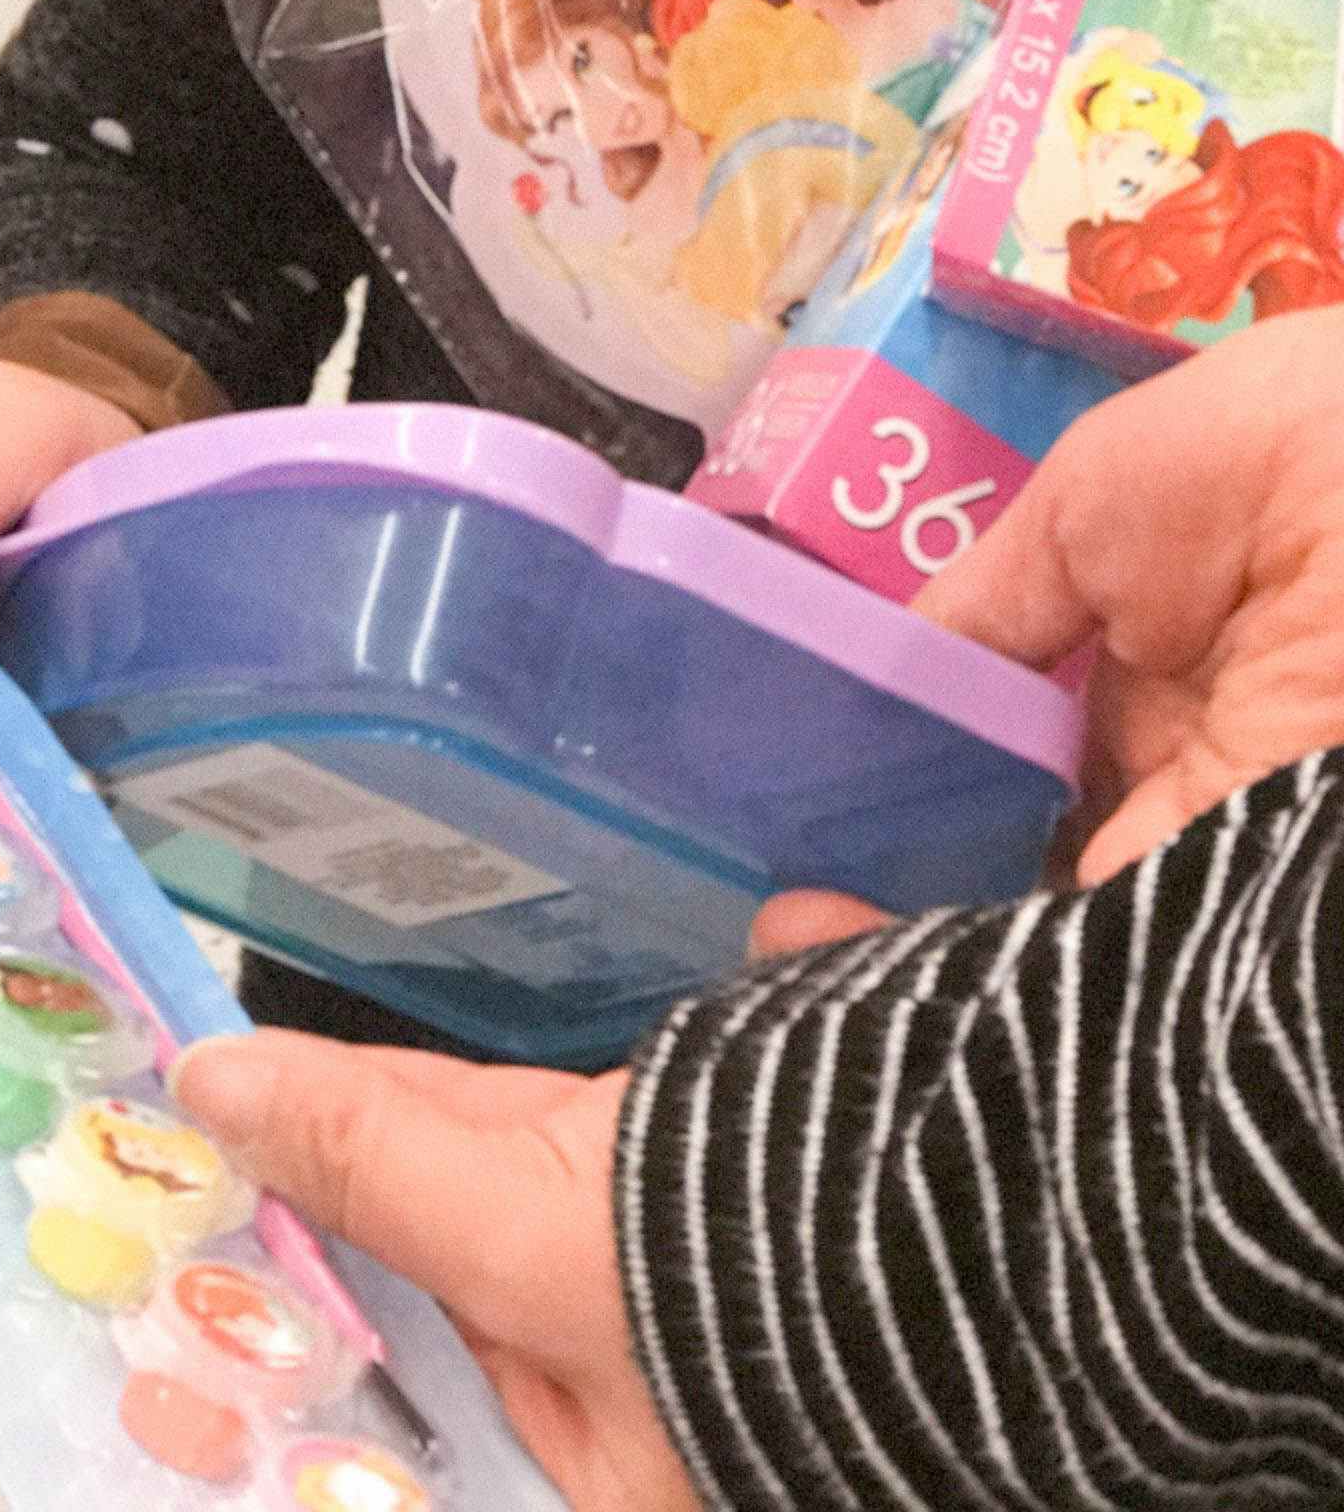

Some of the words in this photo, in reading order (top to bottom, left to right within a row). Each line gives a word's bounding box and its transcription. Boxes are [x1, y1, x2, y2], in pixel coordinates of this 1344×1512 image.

[999, 37, 1057, 111] 15.2
[965, 115, 1020, 183] cm)
[831, 416, 997, 577] 36
